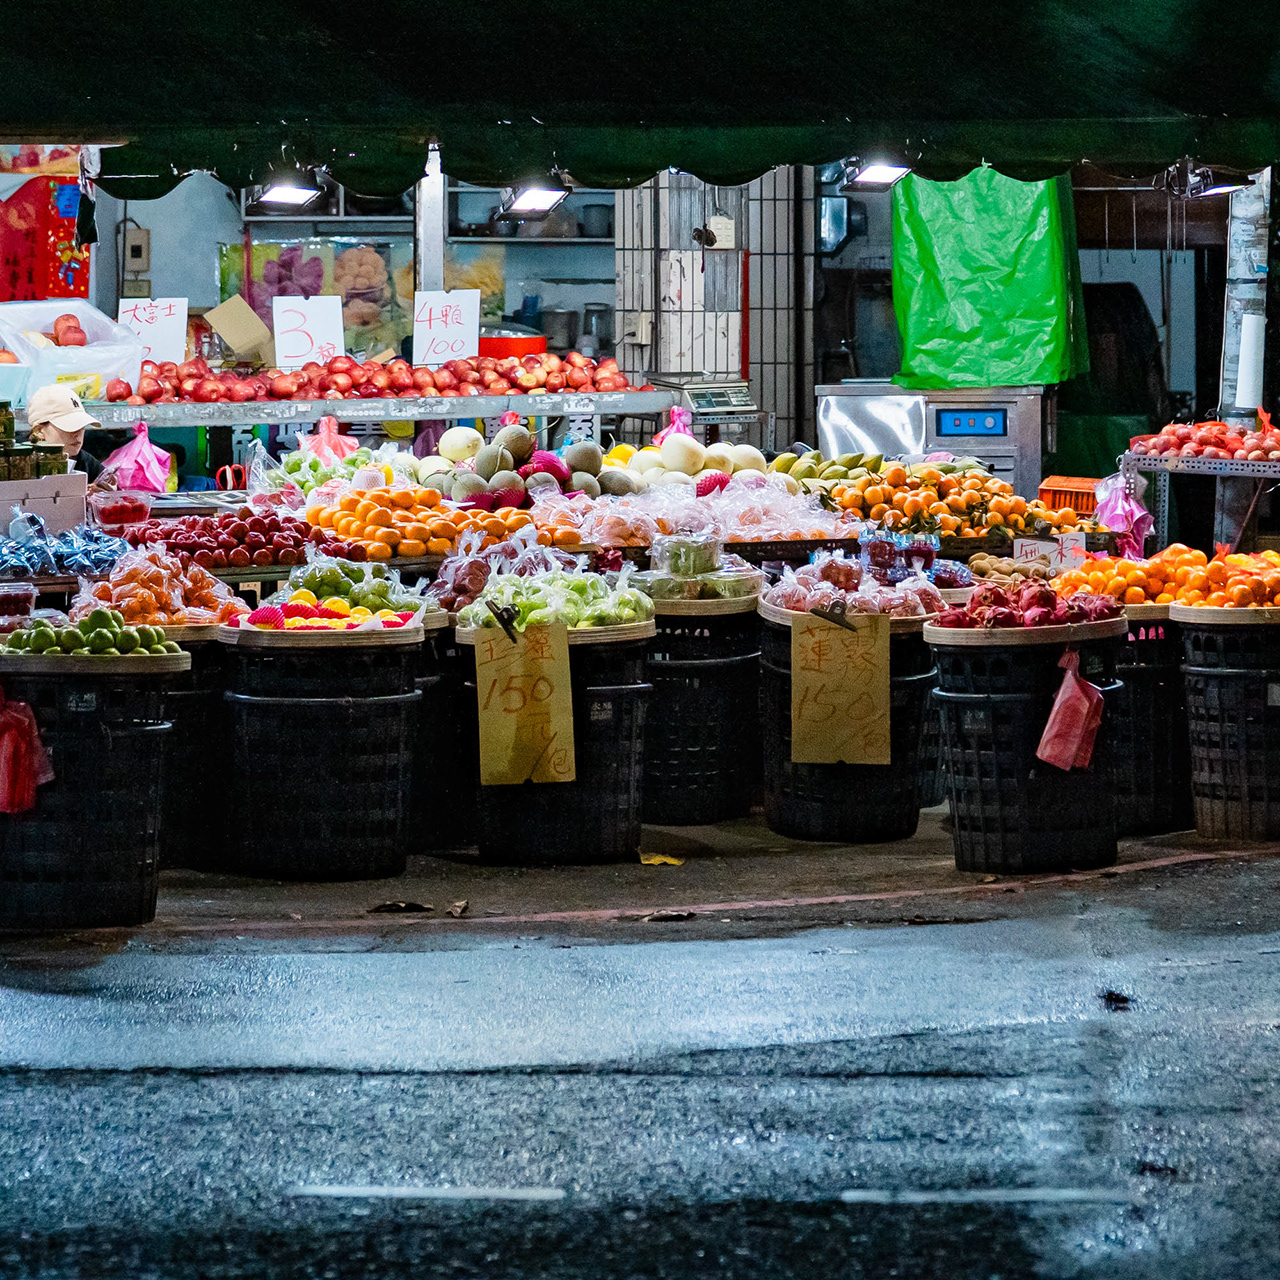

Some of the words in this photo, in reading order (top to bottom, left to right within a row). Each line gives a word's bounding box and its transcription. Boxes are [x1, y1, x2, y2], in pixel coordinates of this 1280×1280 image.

[122, 302, 176, 325] 大富士
[422, 337, 465, 362] 100
[482, 674, 555, 714] 150
[797, 683, 877, 723] 150
